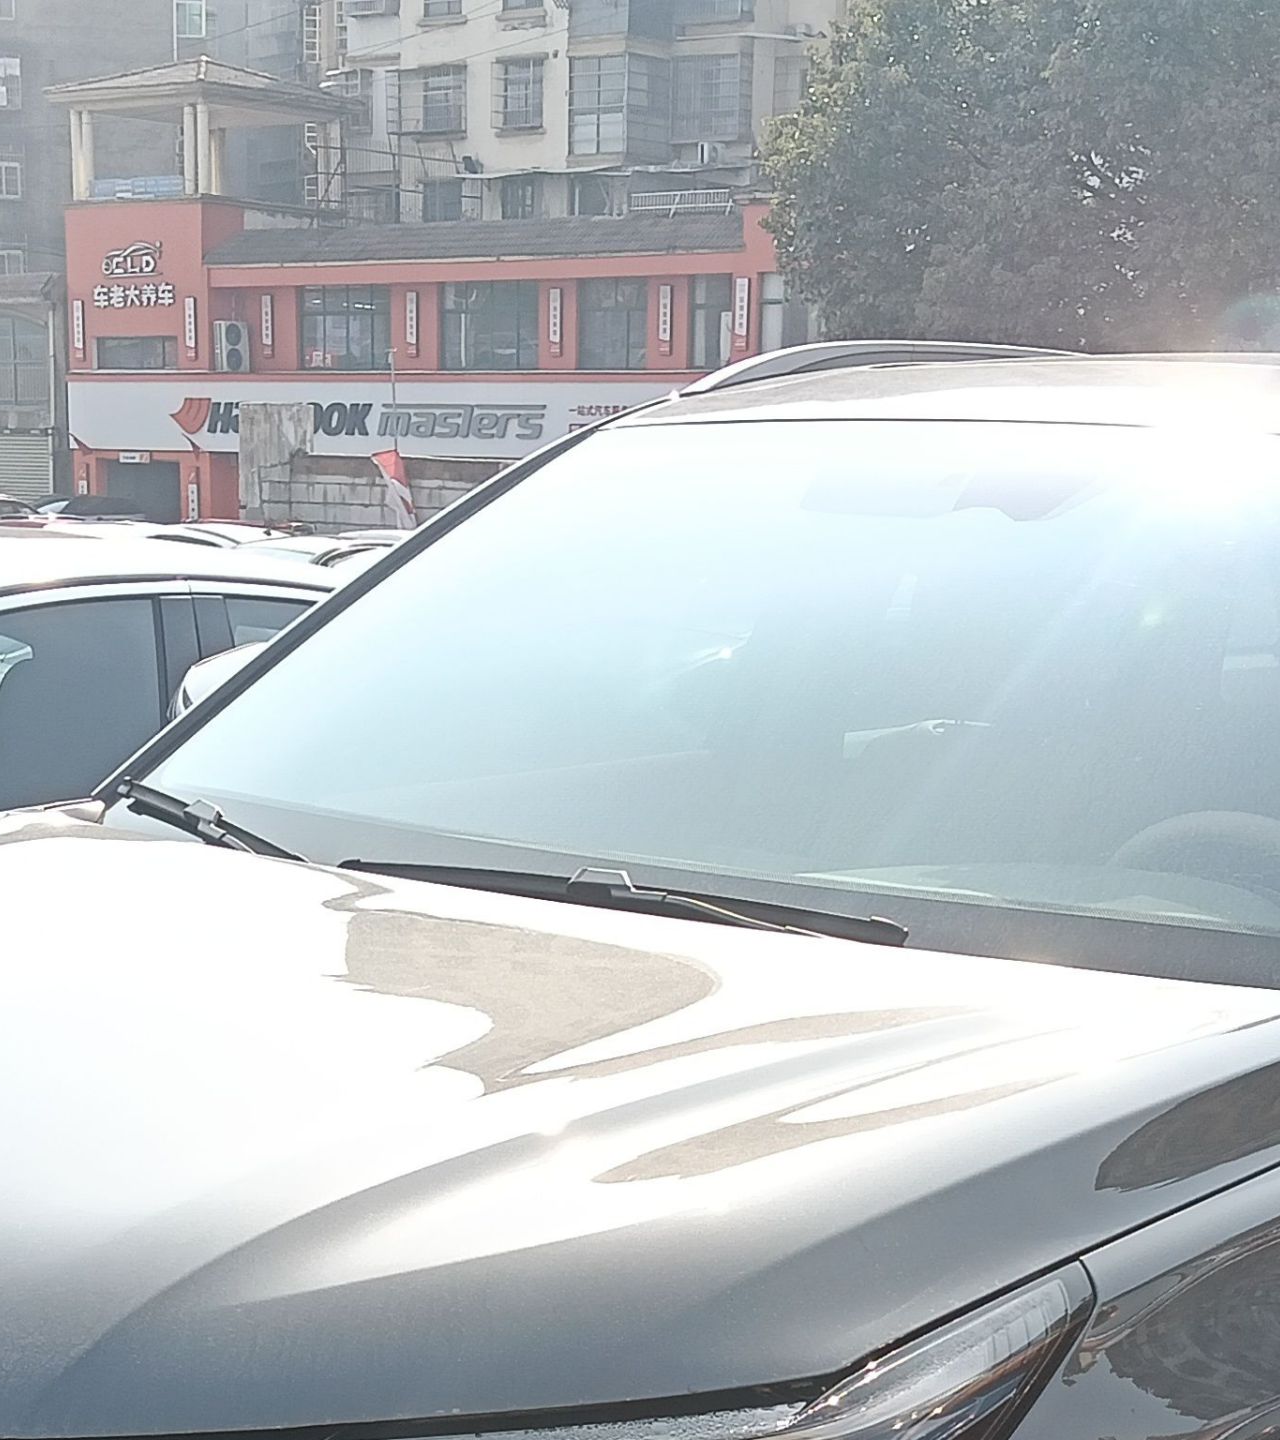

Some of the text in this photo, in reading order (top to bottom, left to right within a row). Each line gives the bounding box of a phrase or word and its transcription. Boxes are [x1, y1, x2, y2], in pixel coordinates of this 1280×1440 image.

[93, 283, 175, 308] 车老大养车
[377, 404, 547, 440] masters
